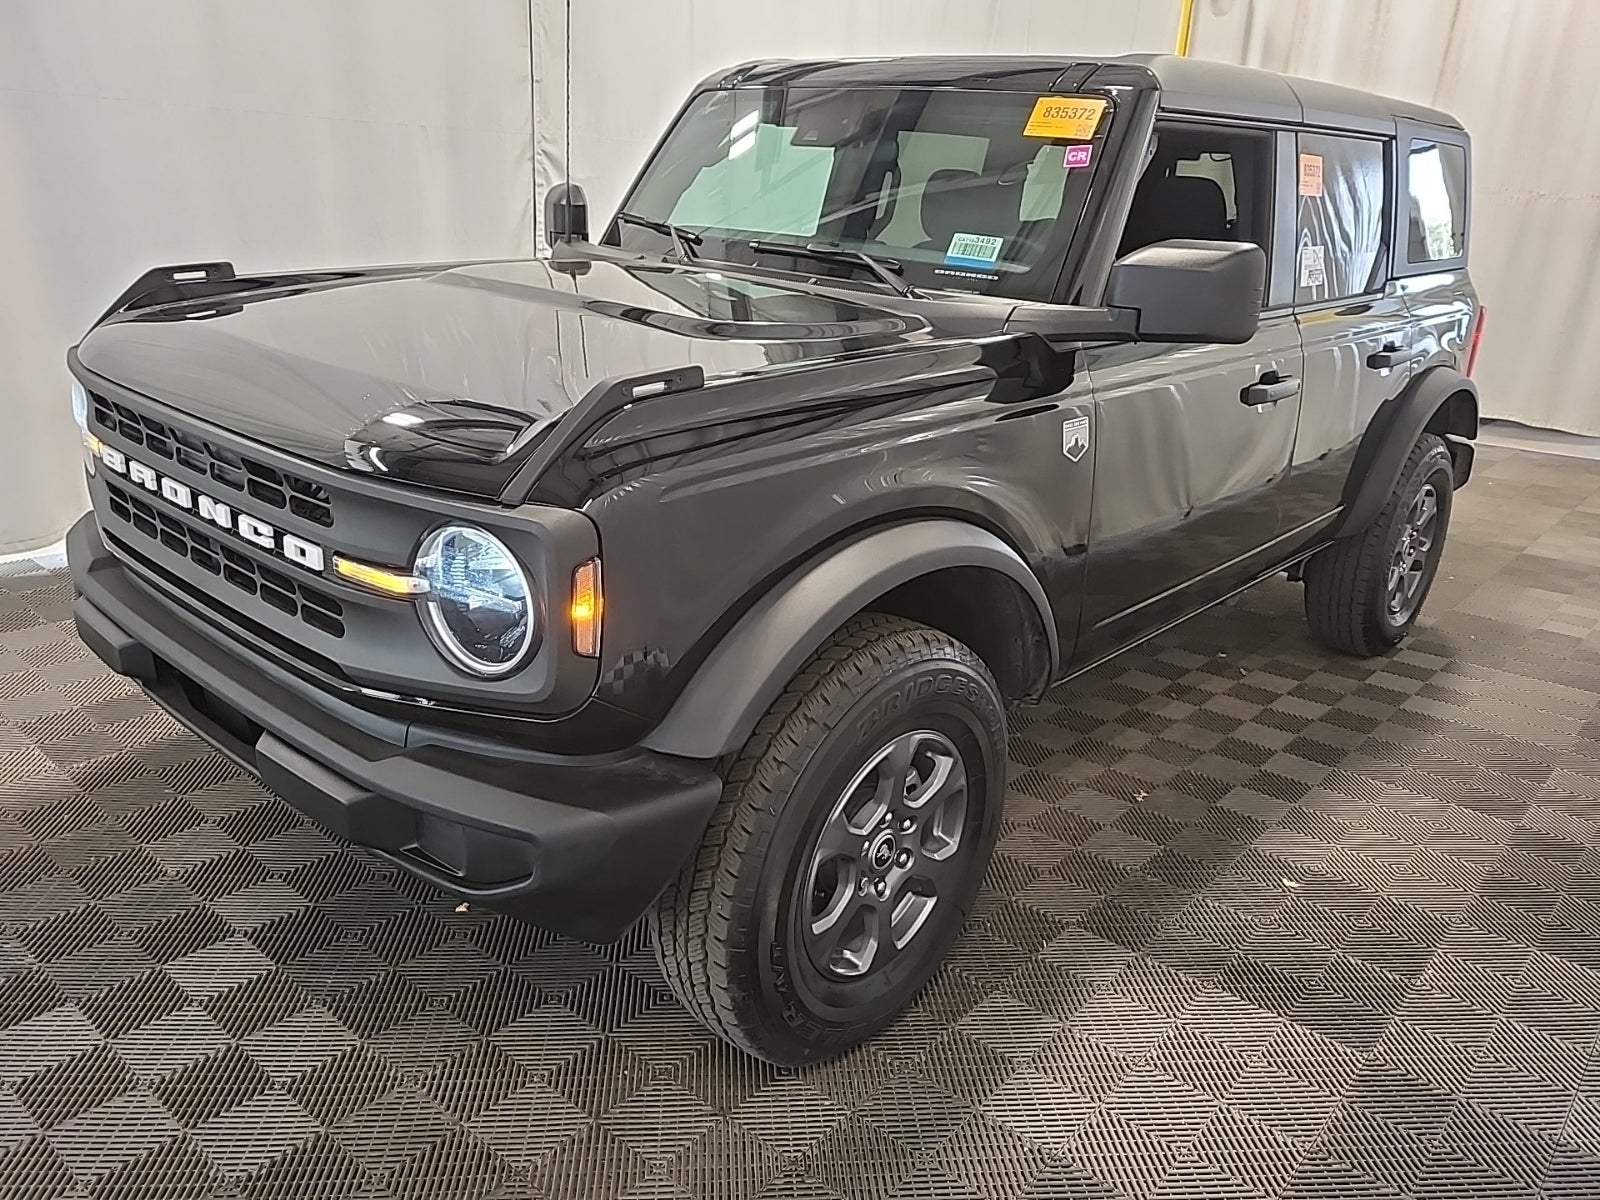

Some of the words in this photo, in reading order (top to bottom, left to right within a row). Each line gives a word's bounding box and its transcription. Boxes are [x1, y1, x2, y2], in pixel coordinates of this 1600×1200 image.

[1043, 106, 1096, 120] 835372
[1068, 151, 1087, 162] CR
[934, 269, 999, 281] BRONCO
[102, 445, 325, 571] BRONCO
